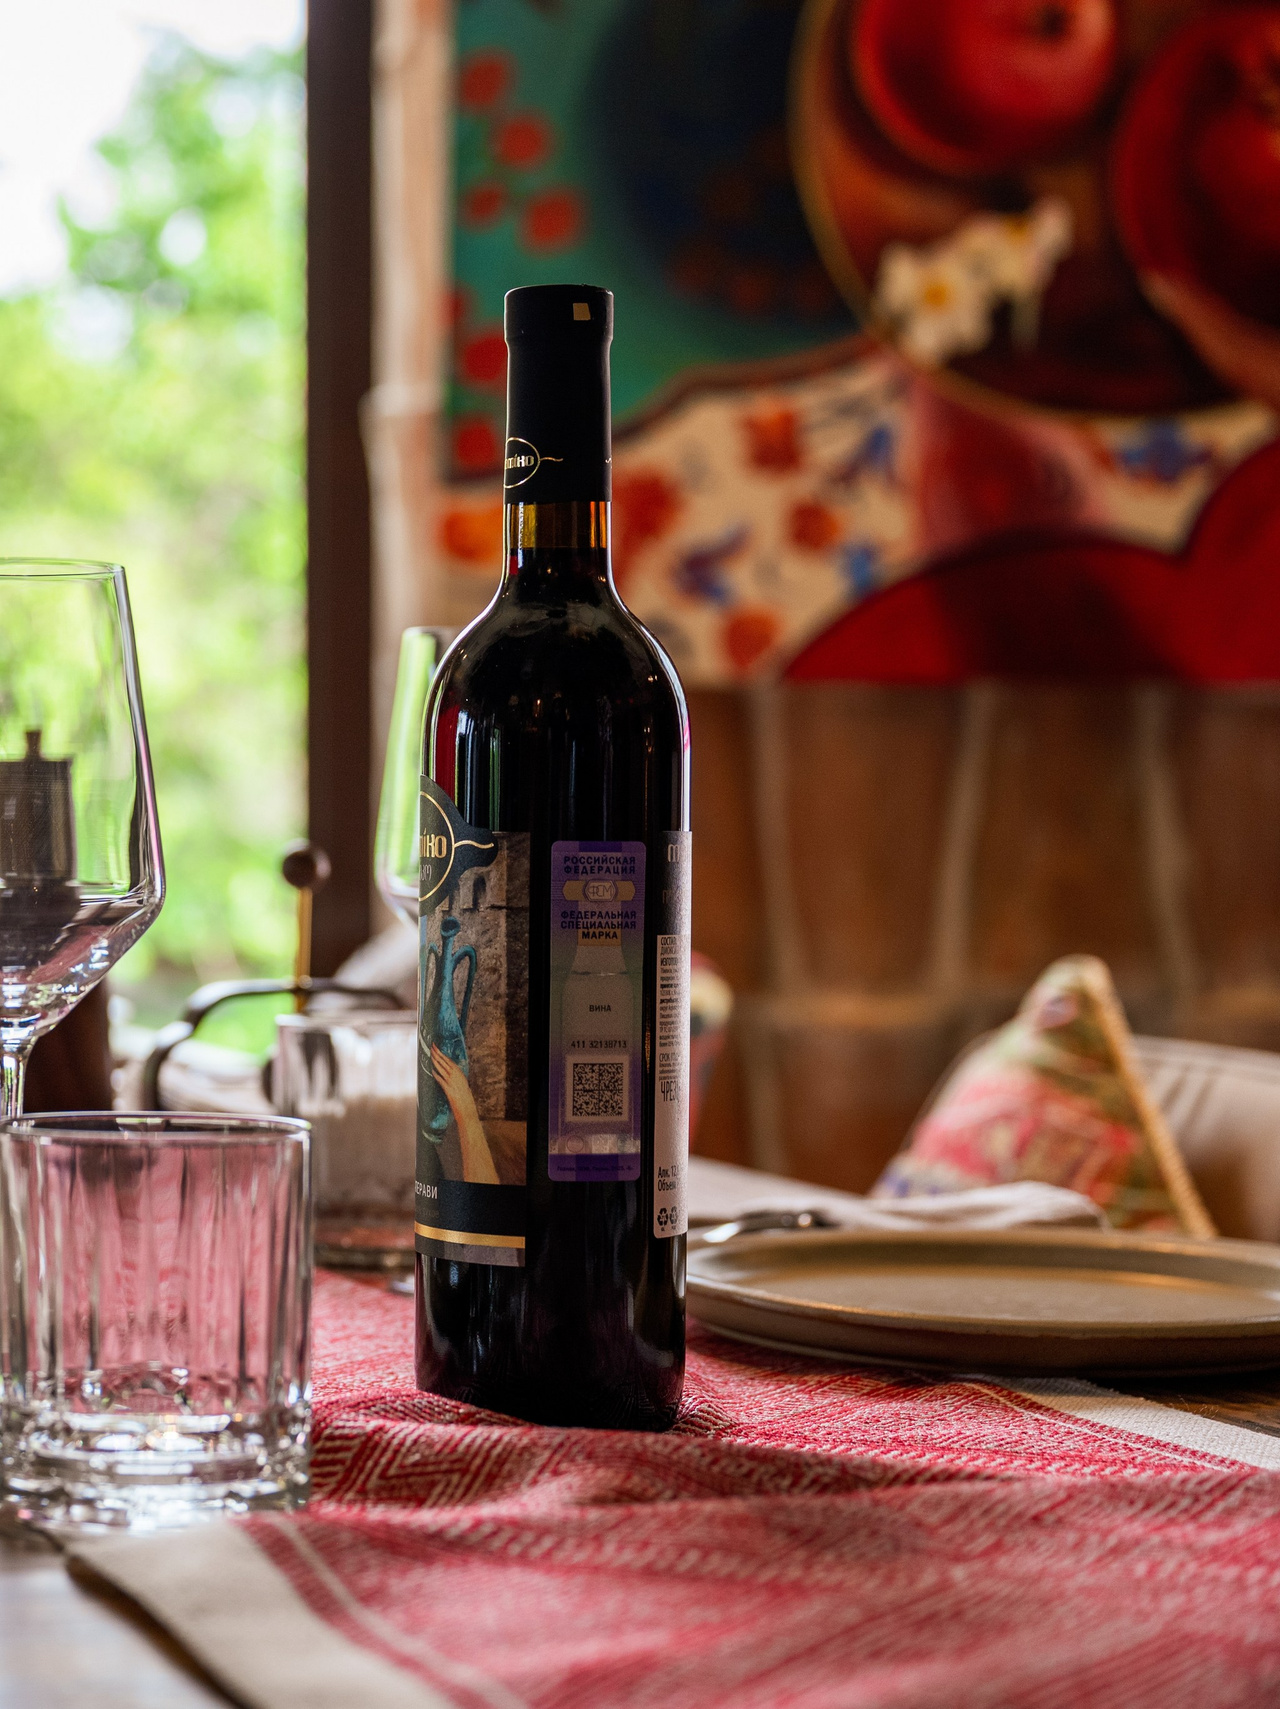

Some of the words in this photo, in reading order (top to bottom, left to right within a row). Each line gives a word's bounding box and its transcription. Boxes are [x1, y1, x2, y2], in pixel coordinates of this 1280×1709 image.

[563, 854, 636, 865] РОССИЙСКАЯ
[564, 865, 636, 875] ФЕДЕРАЦИЯ
[561, 910, 637, 920] ФЕДЕРАЛЬНАЯ
[561, 920, 637, 931] СПЕЦИАЛЬНАЯ
[581, 931, 618, 940] МАРКА
[588, 1004, 612, 1013] ВИНА
[570, 1040, 586, 1049] 411
